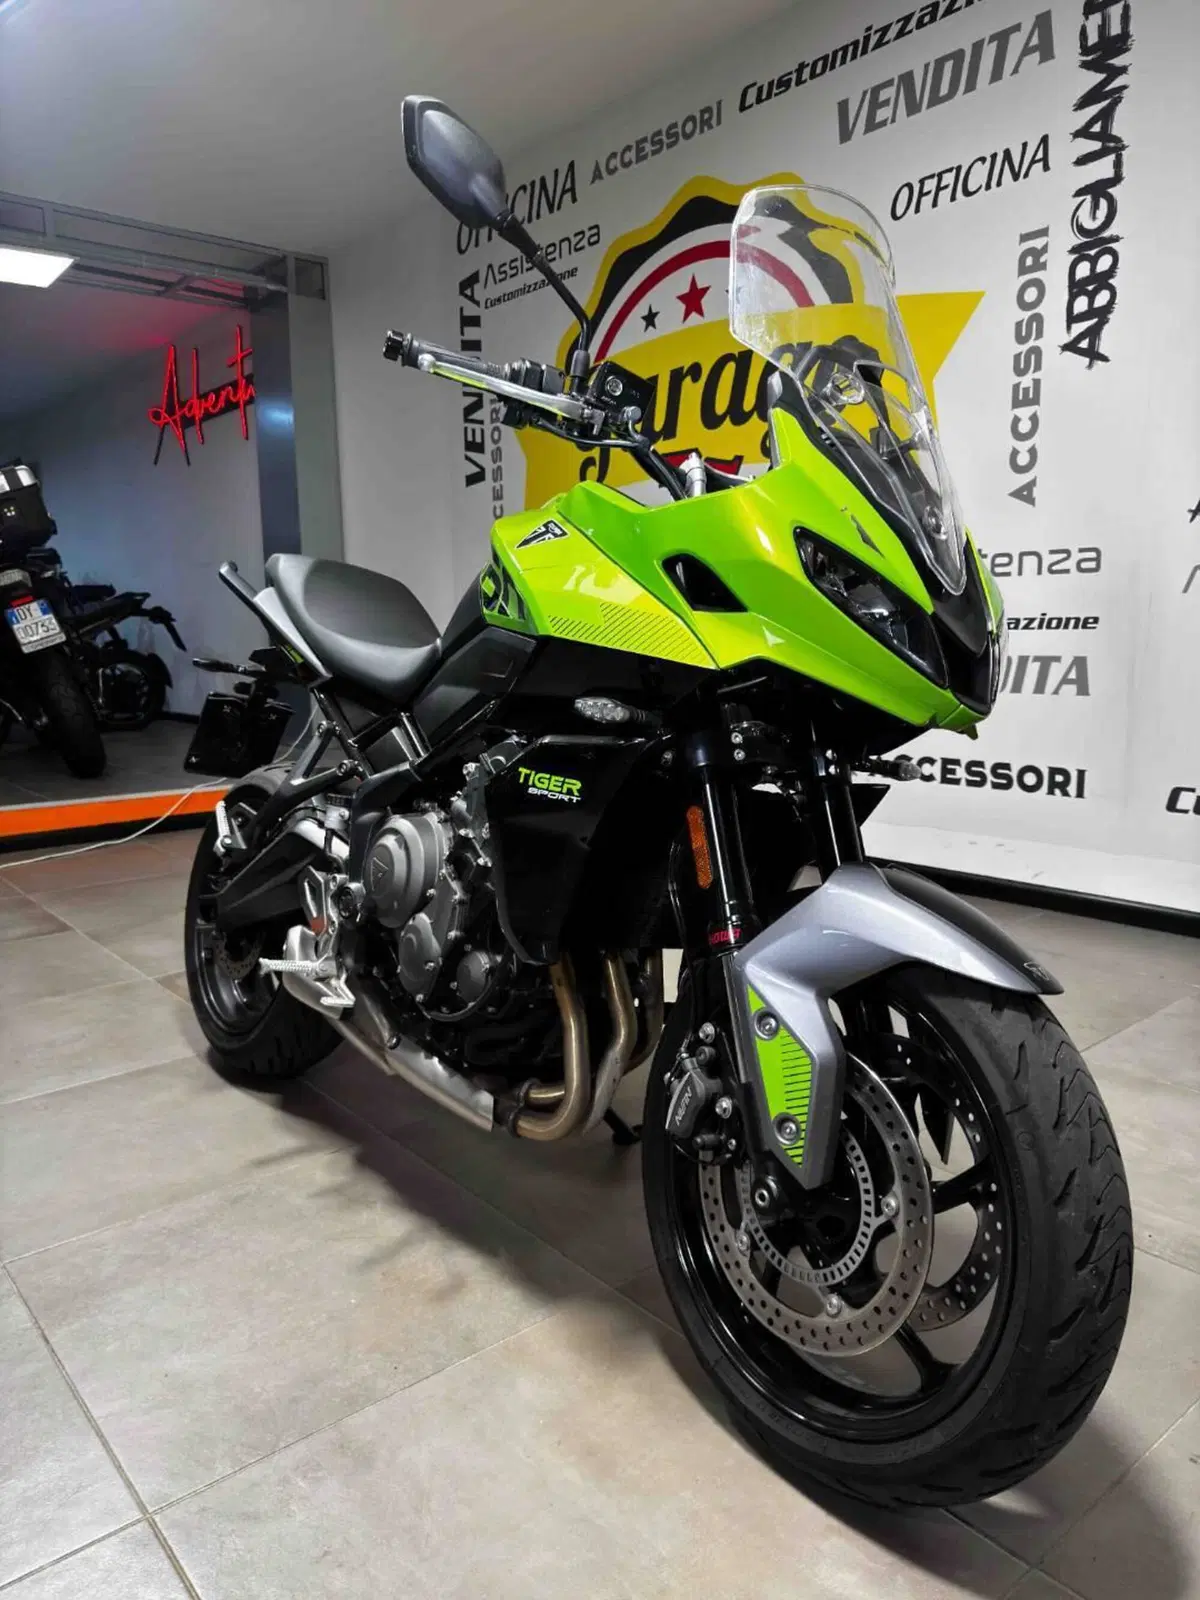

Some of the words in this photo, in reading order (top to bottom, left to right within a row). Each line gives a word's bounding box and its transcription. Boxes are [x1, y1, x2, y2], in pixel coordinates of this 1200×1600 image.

[836, 8, 1056, 145] VENDITA
[589, 98, 724, 187] ACCESSORI
[889, 133, 1052, 221] OFFICINA
[458, 269, 487, 488] VENITA
[1007, 225, 1051, 508] ACCESSORI
[518, 766, 582, 796] TIGER
[527, 786, 581, 804] SPORT
